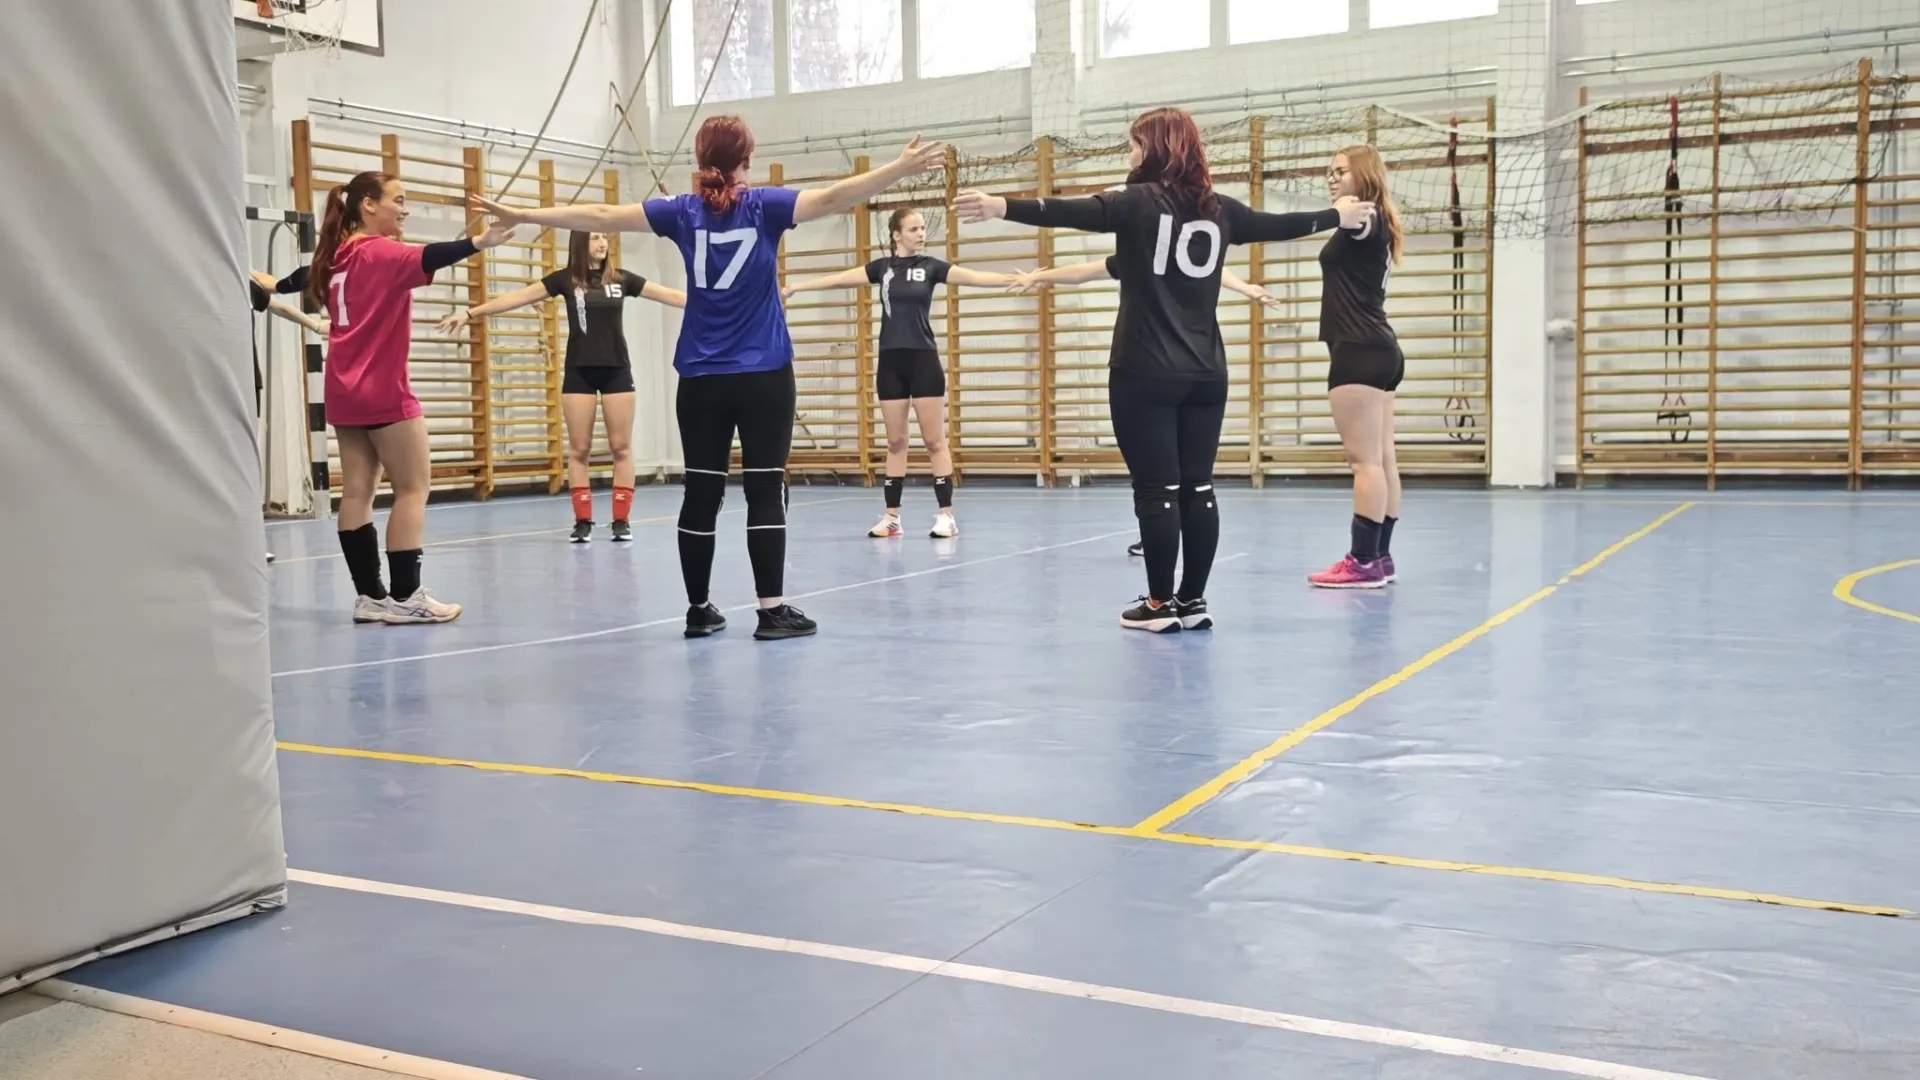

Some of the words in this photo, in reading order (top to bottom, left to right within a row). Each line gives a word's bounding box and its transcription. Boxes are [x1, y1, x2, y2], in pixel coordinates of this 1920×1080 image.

[693, 227, 758, 290] 17
[1153, 213, 1221, 278] 10
[604, 283, 622, 298] 15
[906, 267, 926, 282] 18
